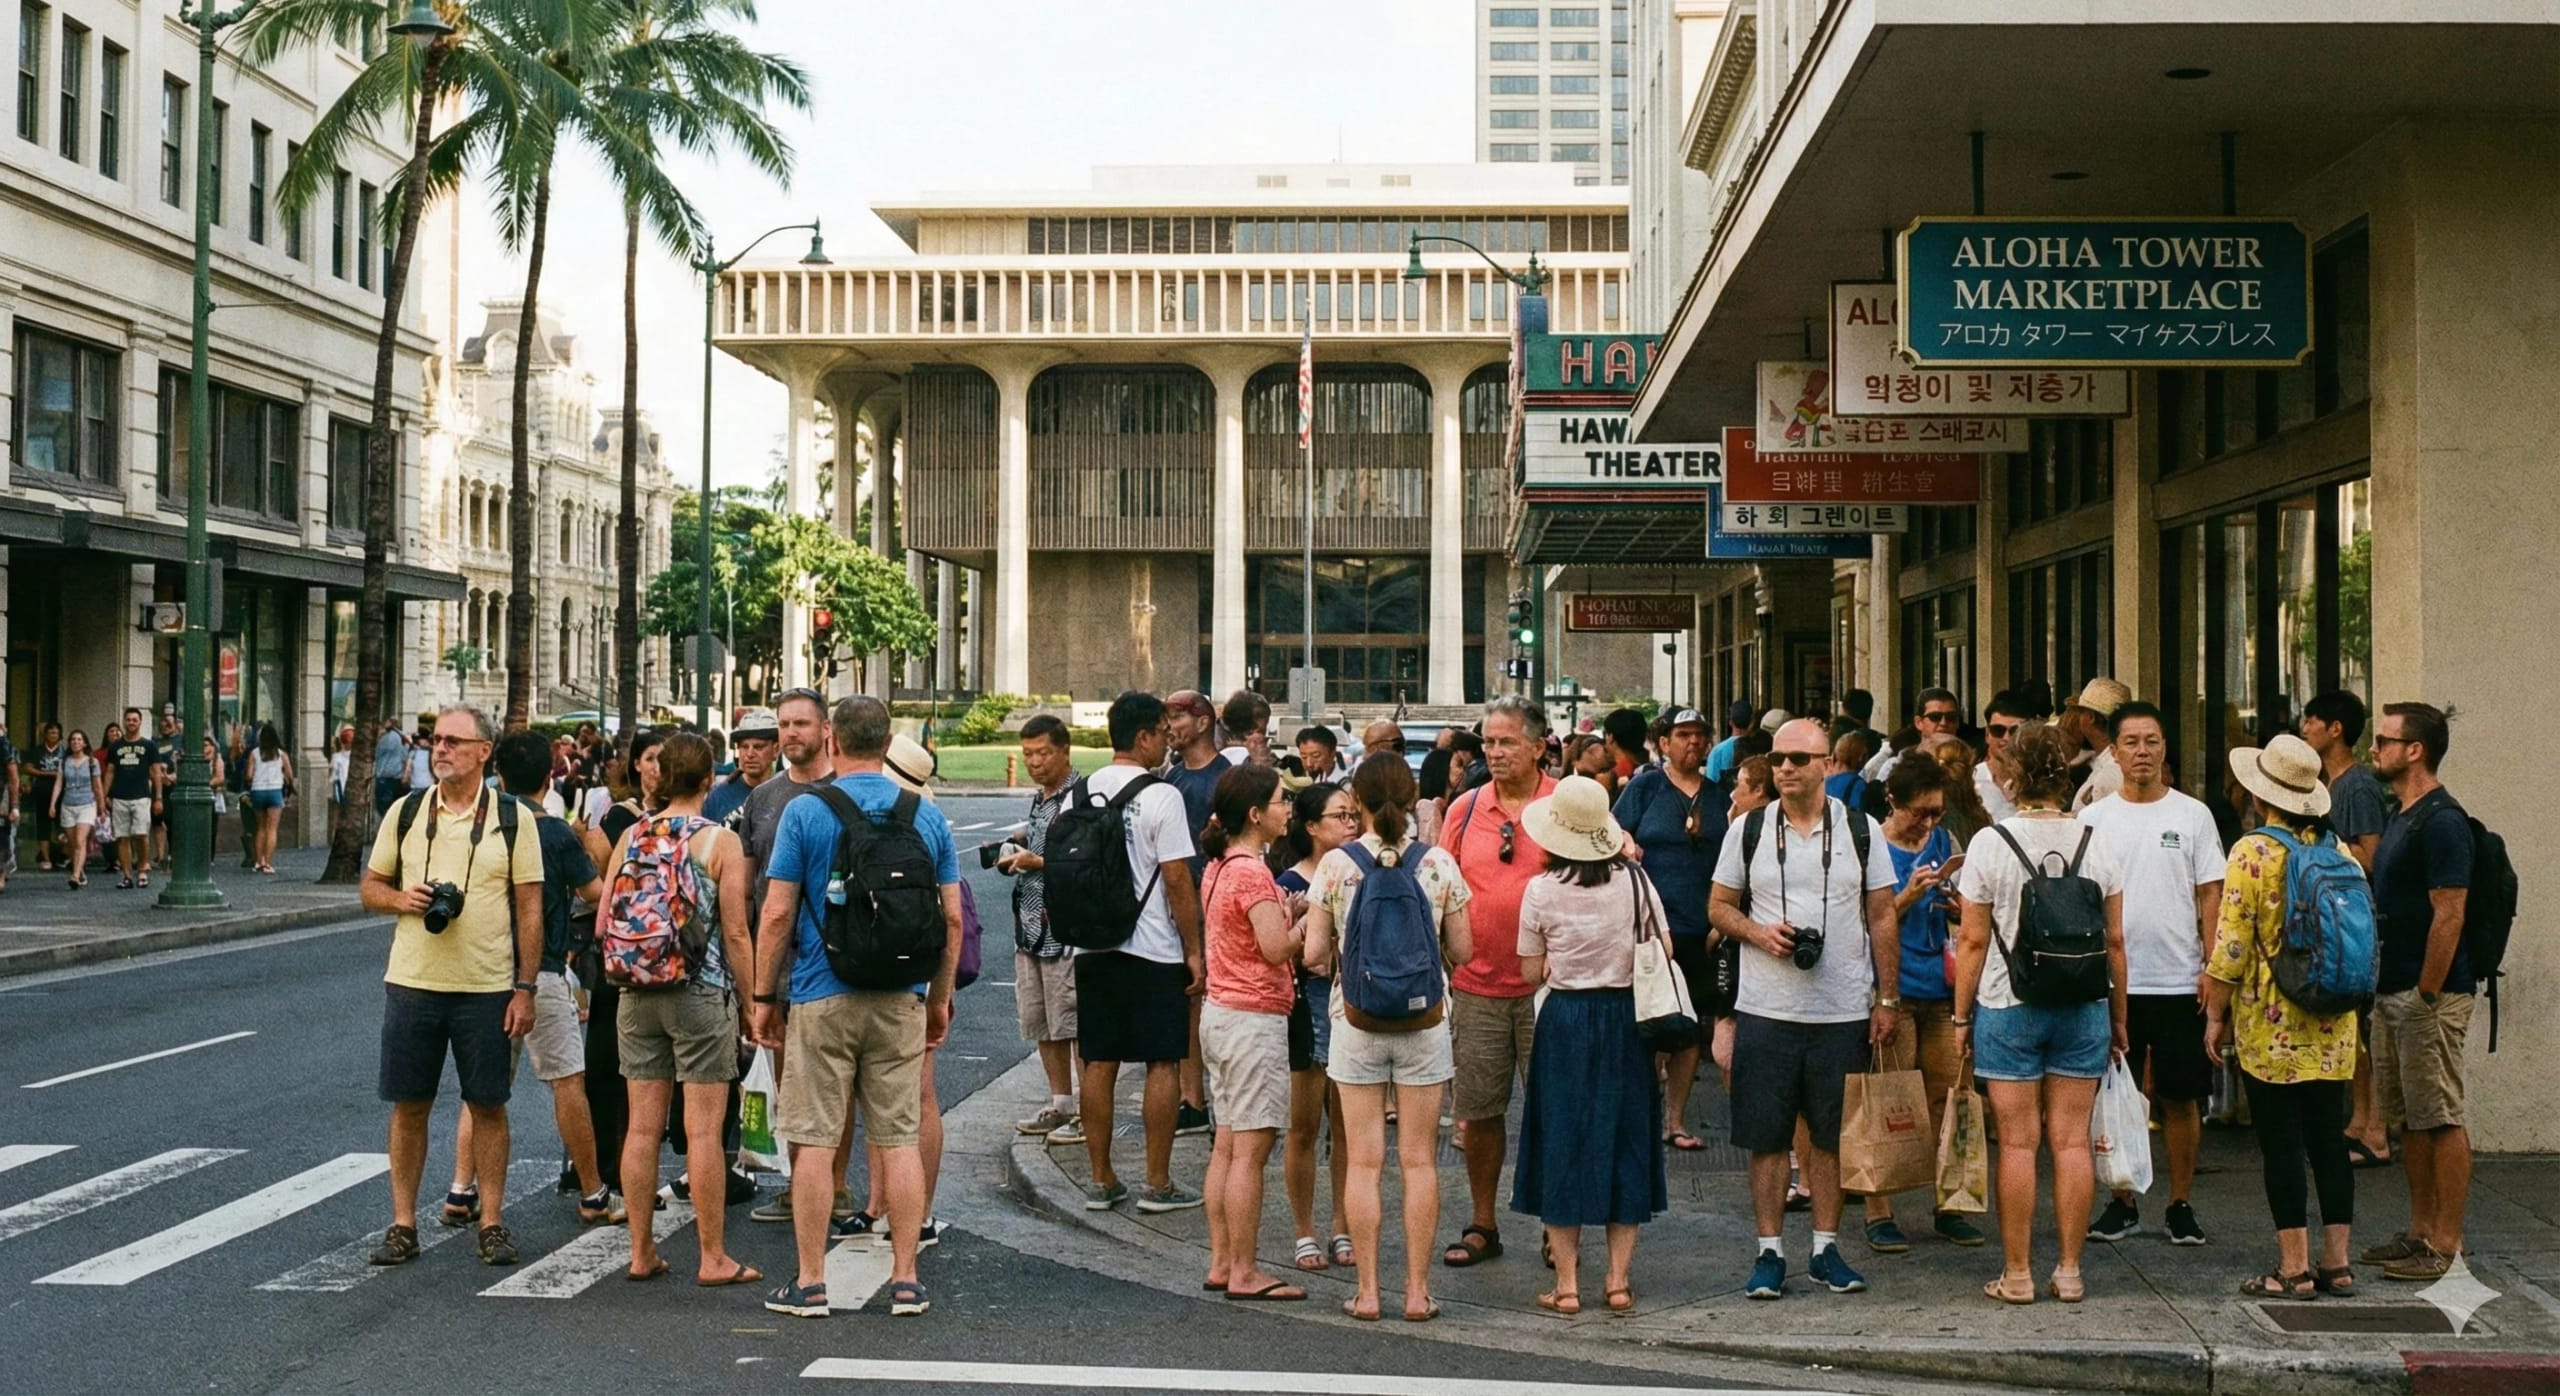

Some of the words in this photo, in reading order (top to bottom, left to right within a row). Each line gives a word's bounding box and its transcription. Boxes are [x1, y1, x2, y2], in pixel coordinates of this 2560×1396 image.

[1952, 237, 2100, 268] ALOHA
[2113, 237, 2264, 268] TOWER
[1953, 280, 2262, 311] MARKETPLACE
[2021, 322, 2093, 347] タワー
[1561, 340, 1657, 385] HA
[1560, 418, 1632, 444] HAW
[1585, 451, 1721, 477] THEATER
